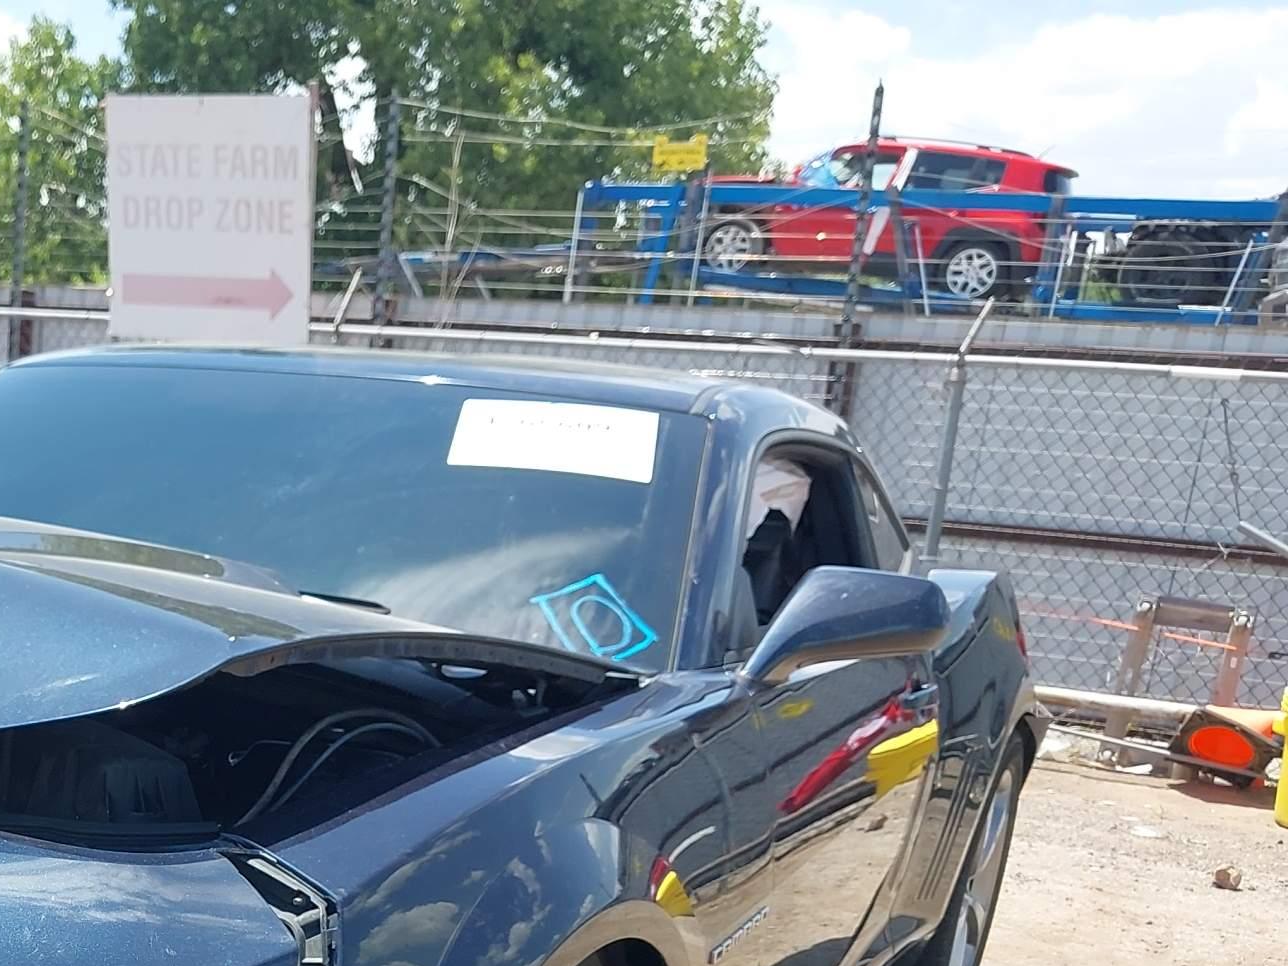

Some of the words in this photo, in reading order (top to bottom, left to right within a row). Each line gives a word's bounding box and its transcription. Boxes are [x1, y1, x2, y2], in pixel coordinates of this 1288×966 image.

[116, 143, 201, 179] STATE
[214, 143, 299, 182] FARM
[122, 195, 203, 231] DROP
[215, 197, 296, 236] ZONE
